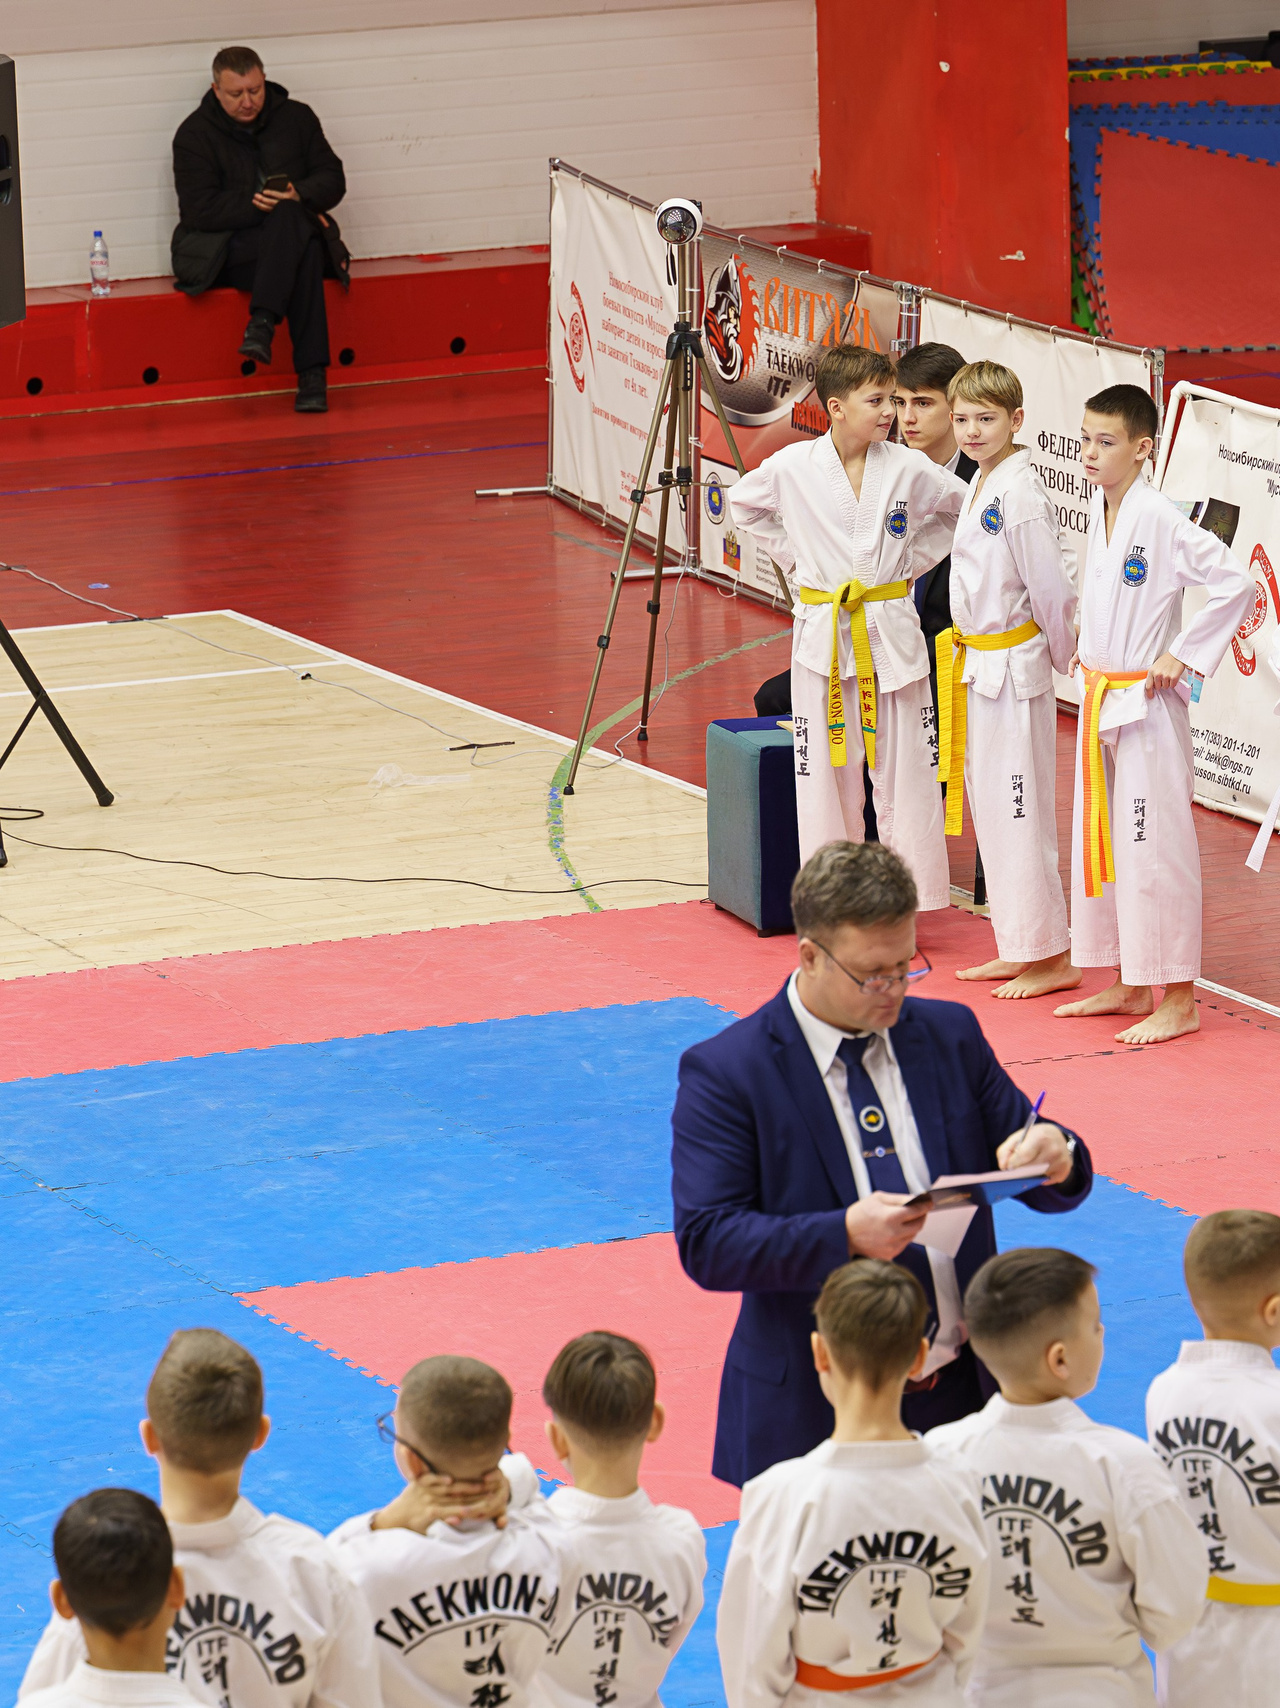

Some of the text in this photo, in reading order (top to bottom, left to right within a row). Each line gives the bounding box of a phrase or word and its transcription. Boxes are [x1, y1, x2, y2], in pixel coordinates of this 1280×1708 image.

[763, 277, 881, 352] ВИТЯЗЬ
[766, 348, 815, 383] TAEKWO
[767, 376, 792, 399] ITF
[1037, 430, 1082, 463] ФЕДЕР
[1218, 444, 1275, 472] Новосибирский
[895, 500, 908, 509] ITF
[1132, 545, 1145, 554] ITF
[794, 716, 808, 726] ITF
[1222, 736, 1261, 760] 201-1-201
[1182, 1458, 1212, 1475] ITF
[982, 1474, 1110, 1568] KWON-DO
[997, 1516, 1033, 1533] ITF
[797, 1530, 972, 1616] TAEKWON-DO
[869, 1568, 908, 1586] ITF
[373, 1572, 560, 1654] TAEKWON-D
[594, 1610, 626, 1626] ITF
[198, 1634, 229, 1656] ITF
[464, 1621, 510, 1648] ITF
